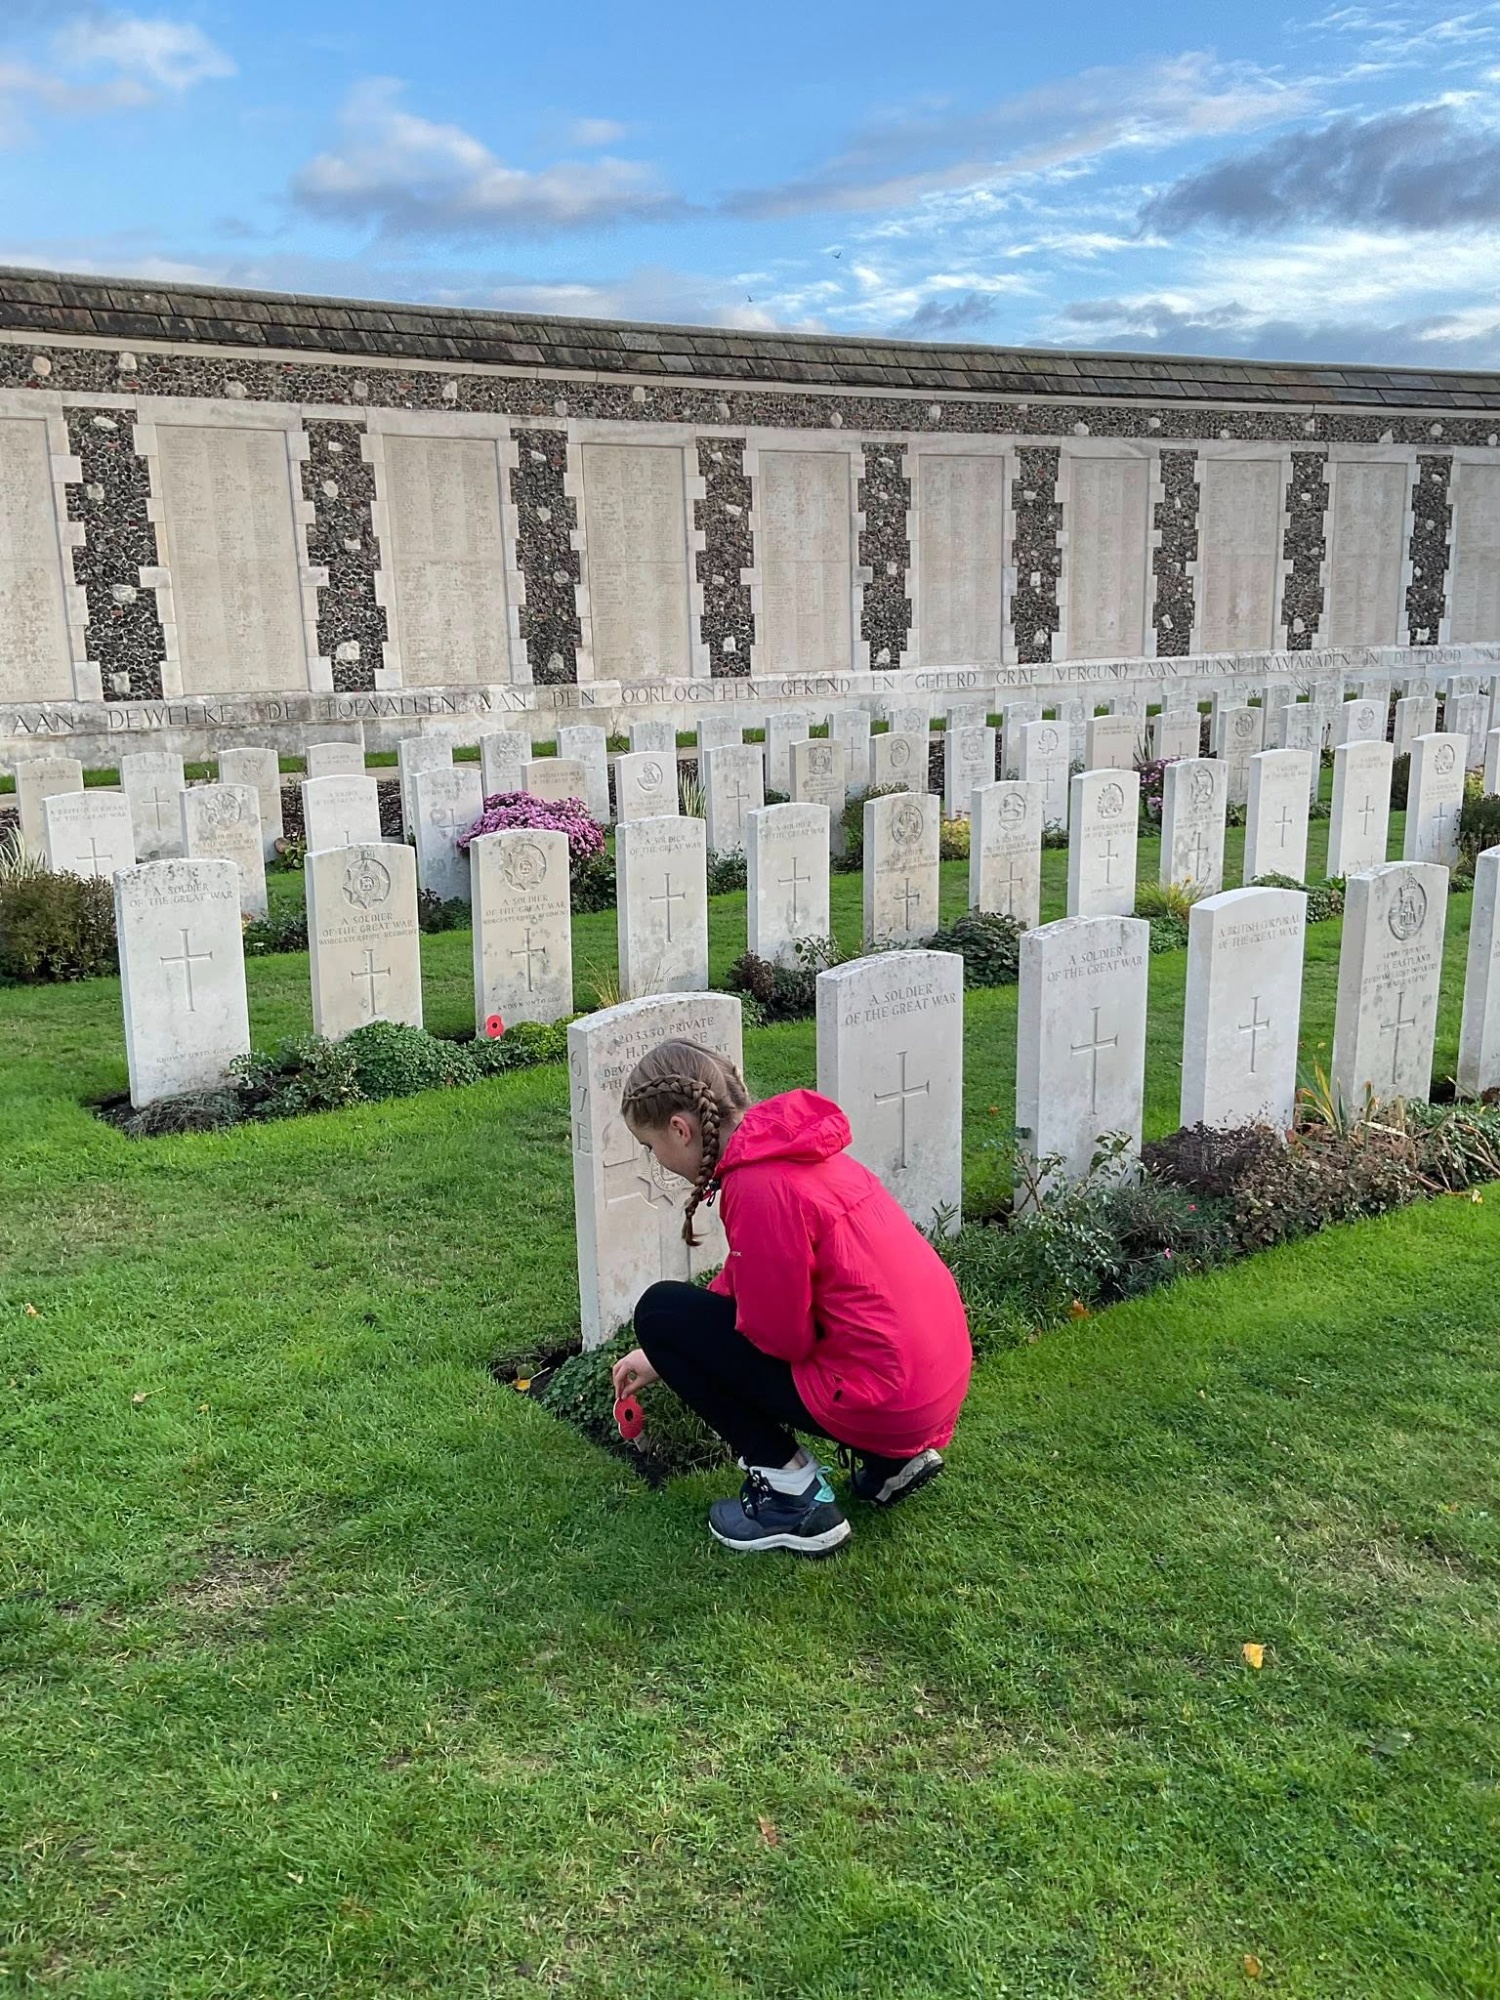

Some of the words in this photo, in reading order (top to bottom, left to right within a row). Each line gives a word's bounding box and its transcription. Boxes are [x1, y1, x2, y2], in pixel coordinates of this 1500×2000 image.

[13, 712, 75, 734] AAN
[267, 701, 299, 721] DE
[326, 695, 457, 719] TOEVALLEN
[481, 691, 527, 710] VAN
[552, 690, 595, 708] DEN
[621, 684, 699, 704] OORLOG
[722, 682, 760, 700] EEN
[781, 677, 850, 696] GEKEND
[872, 676, 895, 692] EN
[996, 668, 1038, 685] GRAF
[1055, 662, 1127, 682] VERGUND
[1146, 661, 1178, 677] AAN
[1195, 657, 1246, 674] HUNNE
[149, 897, 169, 906] THE
[173, 893, 206, 904] GREAT
[210, 890, 233, 900] WAR
[153, 886, 161, 896] A
[167, 882, 209, 894] SOLDIER
[512, 894, 548, 905] SOLDIER
[547, 901, 566, 909] WAR
[341, 917, 349, 926] A
[353, 912, 393, 924] SOLDIER
[322, 928, 335, 938] OF
[337, 926, 357, 936] THE
[360, 922, 390, 933] GREAT
[392, 920, 414, 929] WAR
[1068, 954, 1076, 965] A
[1080, 946, 1123, 963] SOLDIER
[1047, 970, 1061, 982] OF
[1063, 966, 1085, 979] THE
[1086, 960, 1120, 975] GREAT
[1121, 955, 1143, 968] WAR
[868, 994, 880, 1006] A
[884, 983, 933, 1003] SOLDIER
[845, 1012, 861, 1026] OF
[864, 1006, 889, 1022] THE
[891, 998, 929, 1016] GREAT
[931, 992, 957, 1006] WAR
[669, 1016, 714, 1034] PRIVATE
